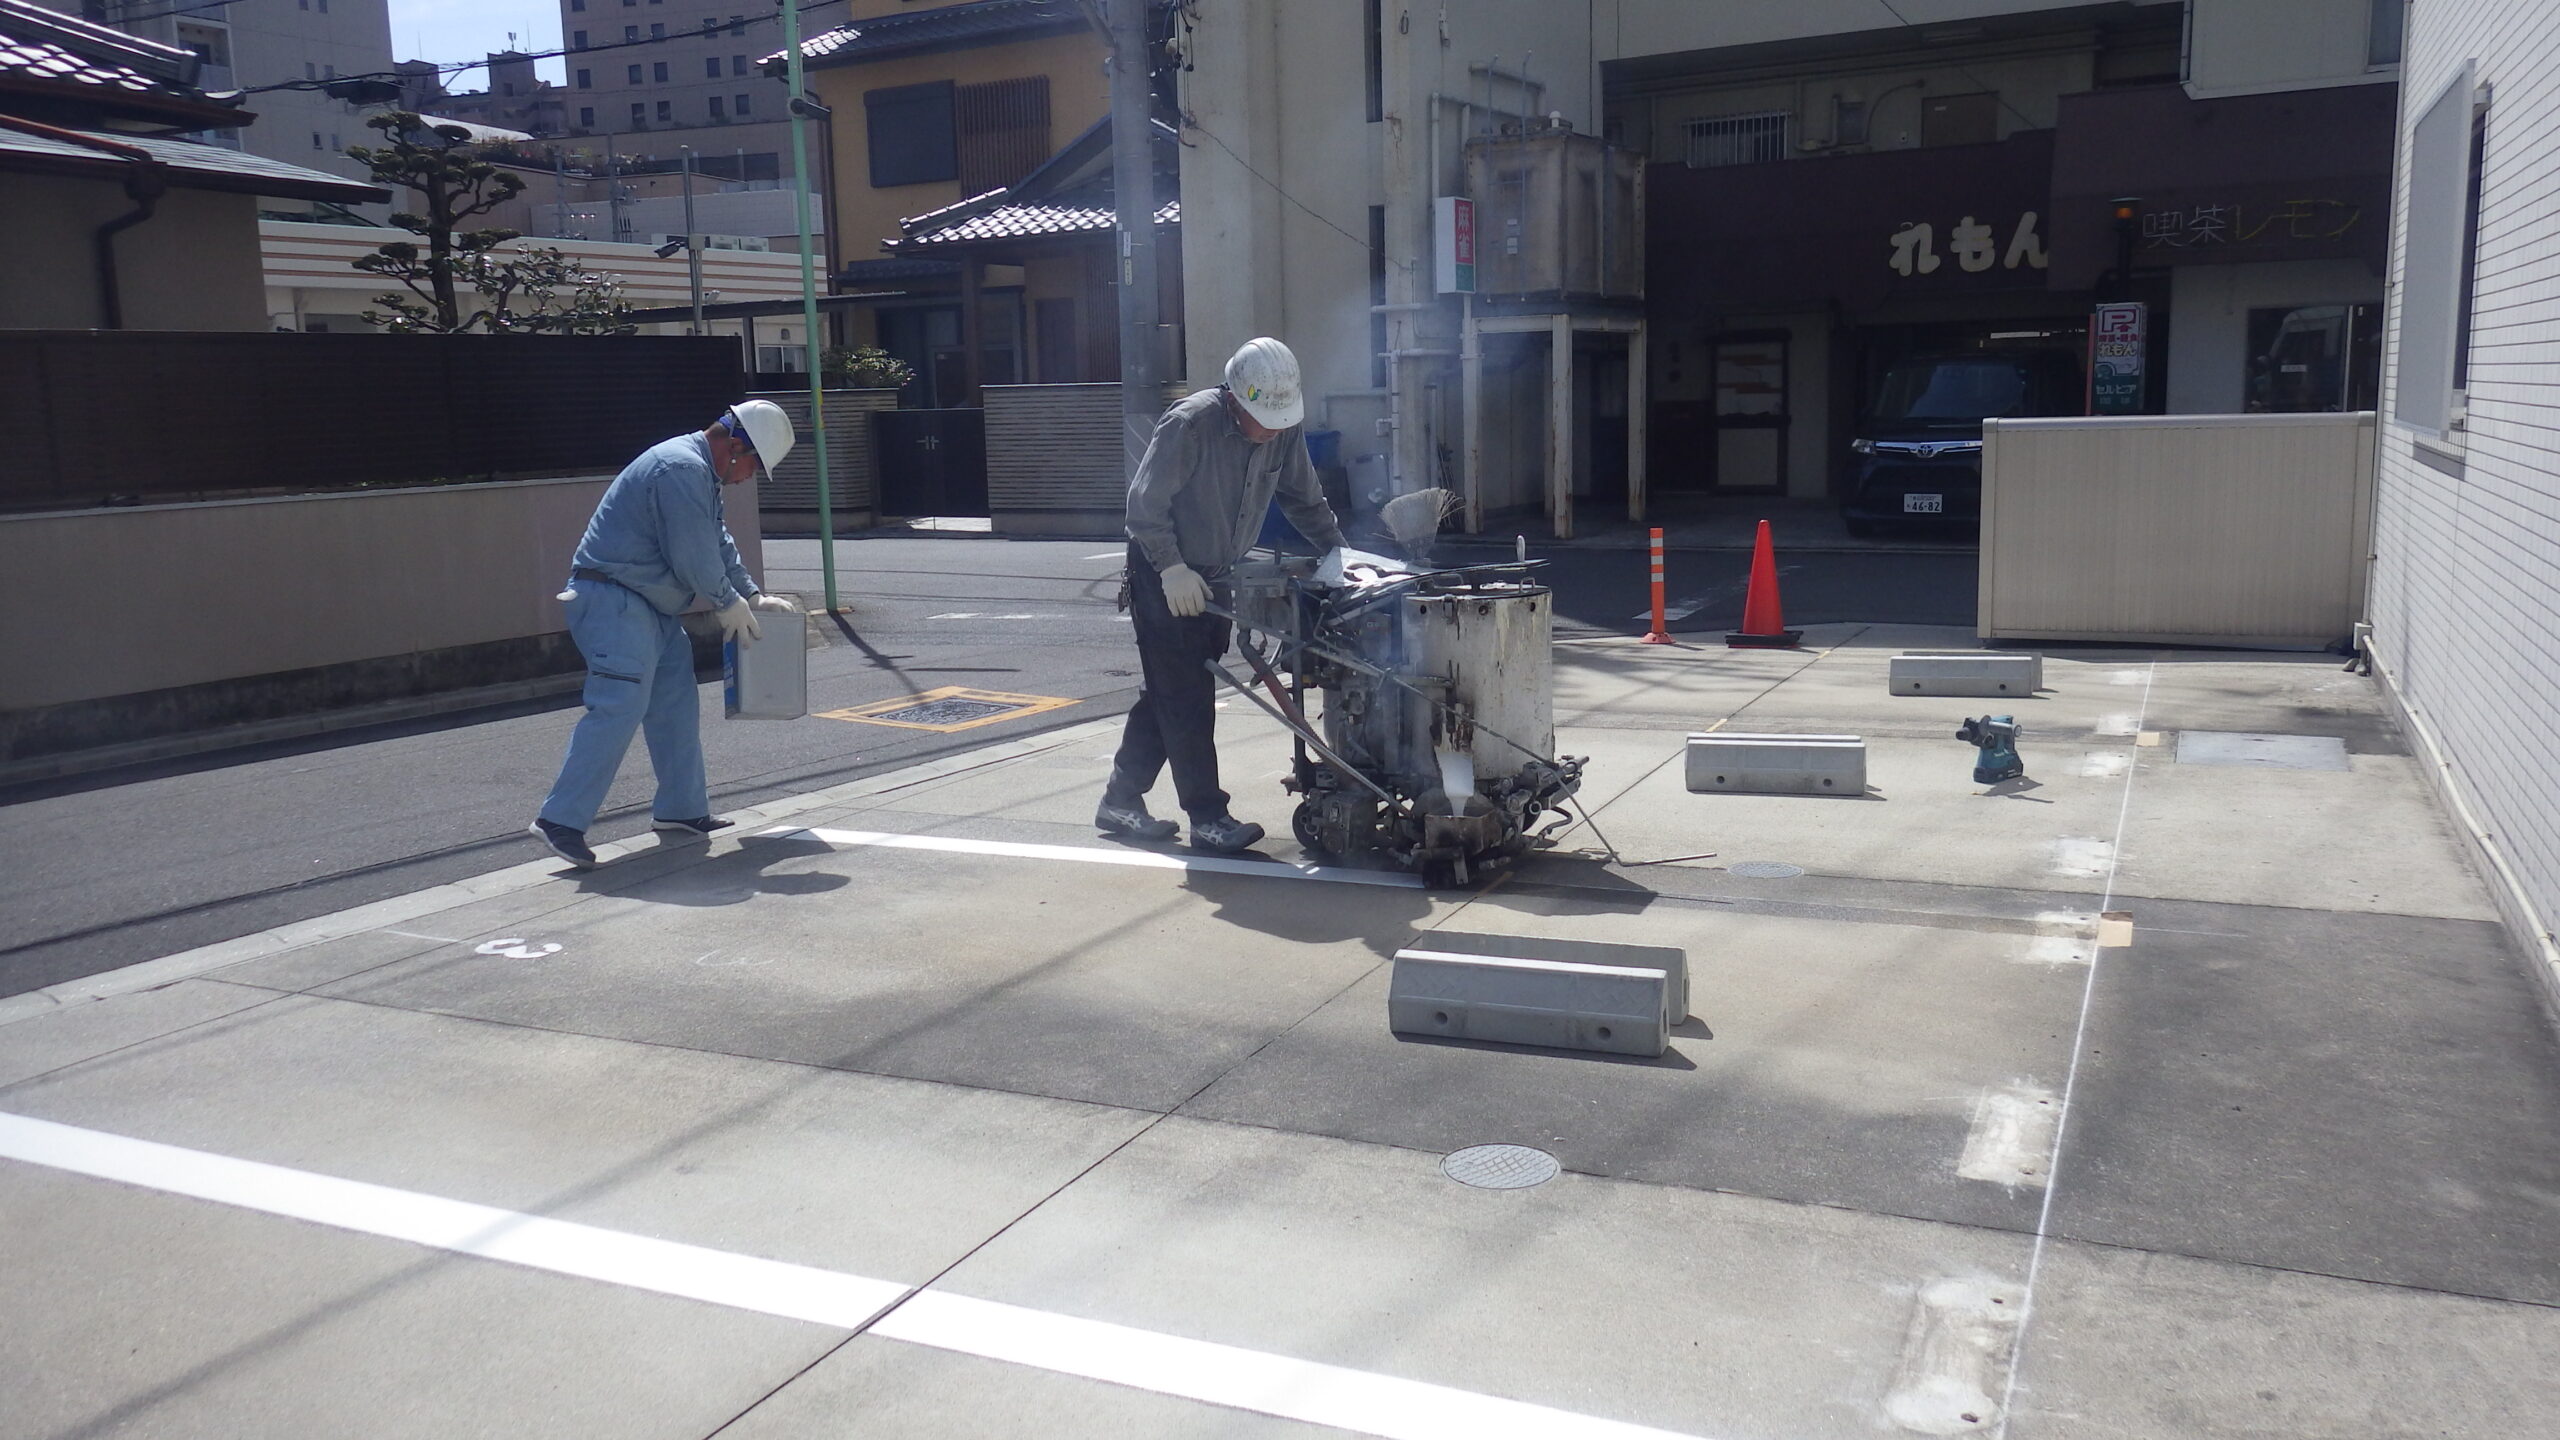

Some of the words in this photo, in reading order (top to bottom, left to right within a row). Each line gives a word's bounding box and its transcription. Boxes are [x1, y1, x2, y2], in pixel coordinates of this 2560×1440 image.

[1458, 205, 1470, 258] 麻雀
[1889, 211, 2048, 277] れもん
[2143, 200, 2361, 249] 喫茶レモン
[2102, 309, 2136, 333] P
[2098, 343, 2137, 356] れもん
